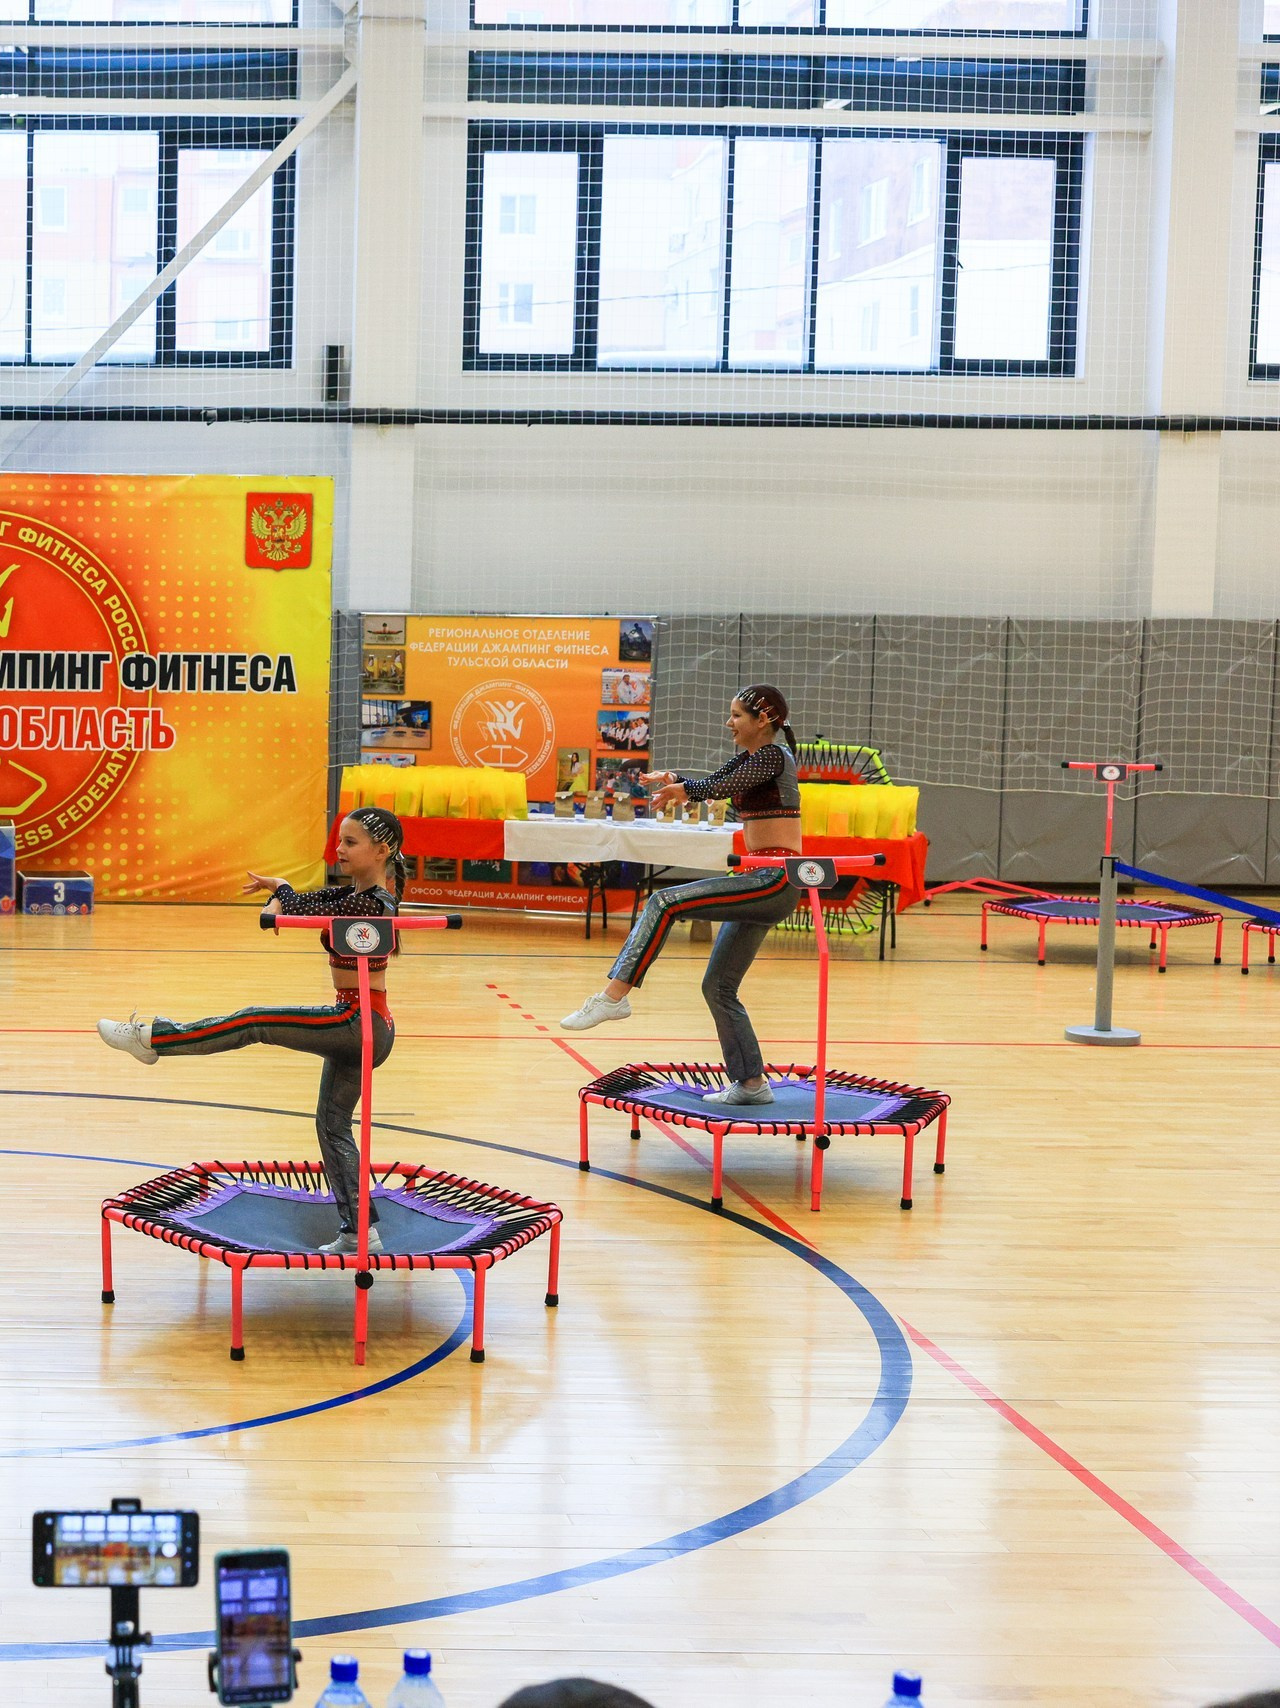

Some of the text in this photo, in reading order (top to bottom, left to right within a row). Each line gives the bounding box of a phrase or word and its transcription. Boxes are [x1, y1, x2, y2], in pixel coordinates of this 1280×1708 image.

[18, 527, 108, 596] ФИТНЕСА
[103, 594, 139, 655] РОСС
[428, 627, 591, 641] РЕГИОНАЛЬНОЕ ОТДЕЛЕНИЕ
[409, 641, 609, 656] ФЕДЕРАЦИИ ДЖАМПИНГ ФИТНЕСА
[447, 656, 569, 669] ТУЛЬСКОЙ ОБЛАСТИ
[121, 651, 298, 694] ФИТНЕСА
[55, 736, 130, 830] FEDERAT
[53, 882, 65, 903] 3
[410, 887, 443, 896] ОФСОО
[496, 892, 545, 901] ДЖАМПИНГ
